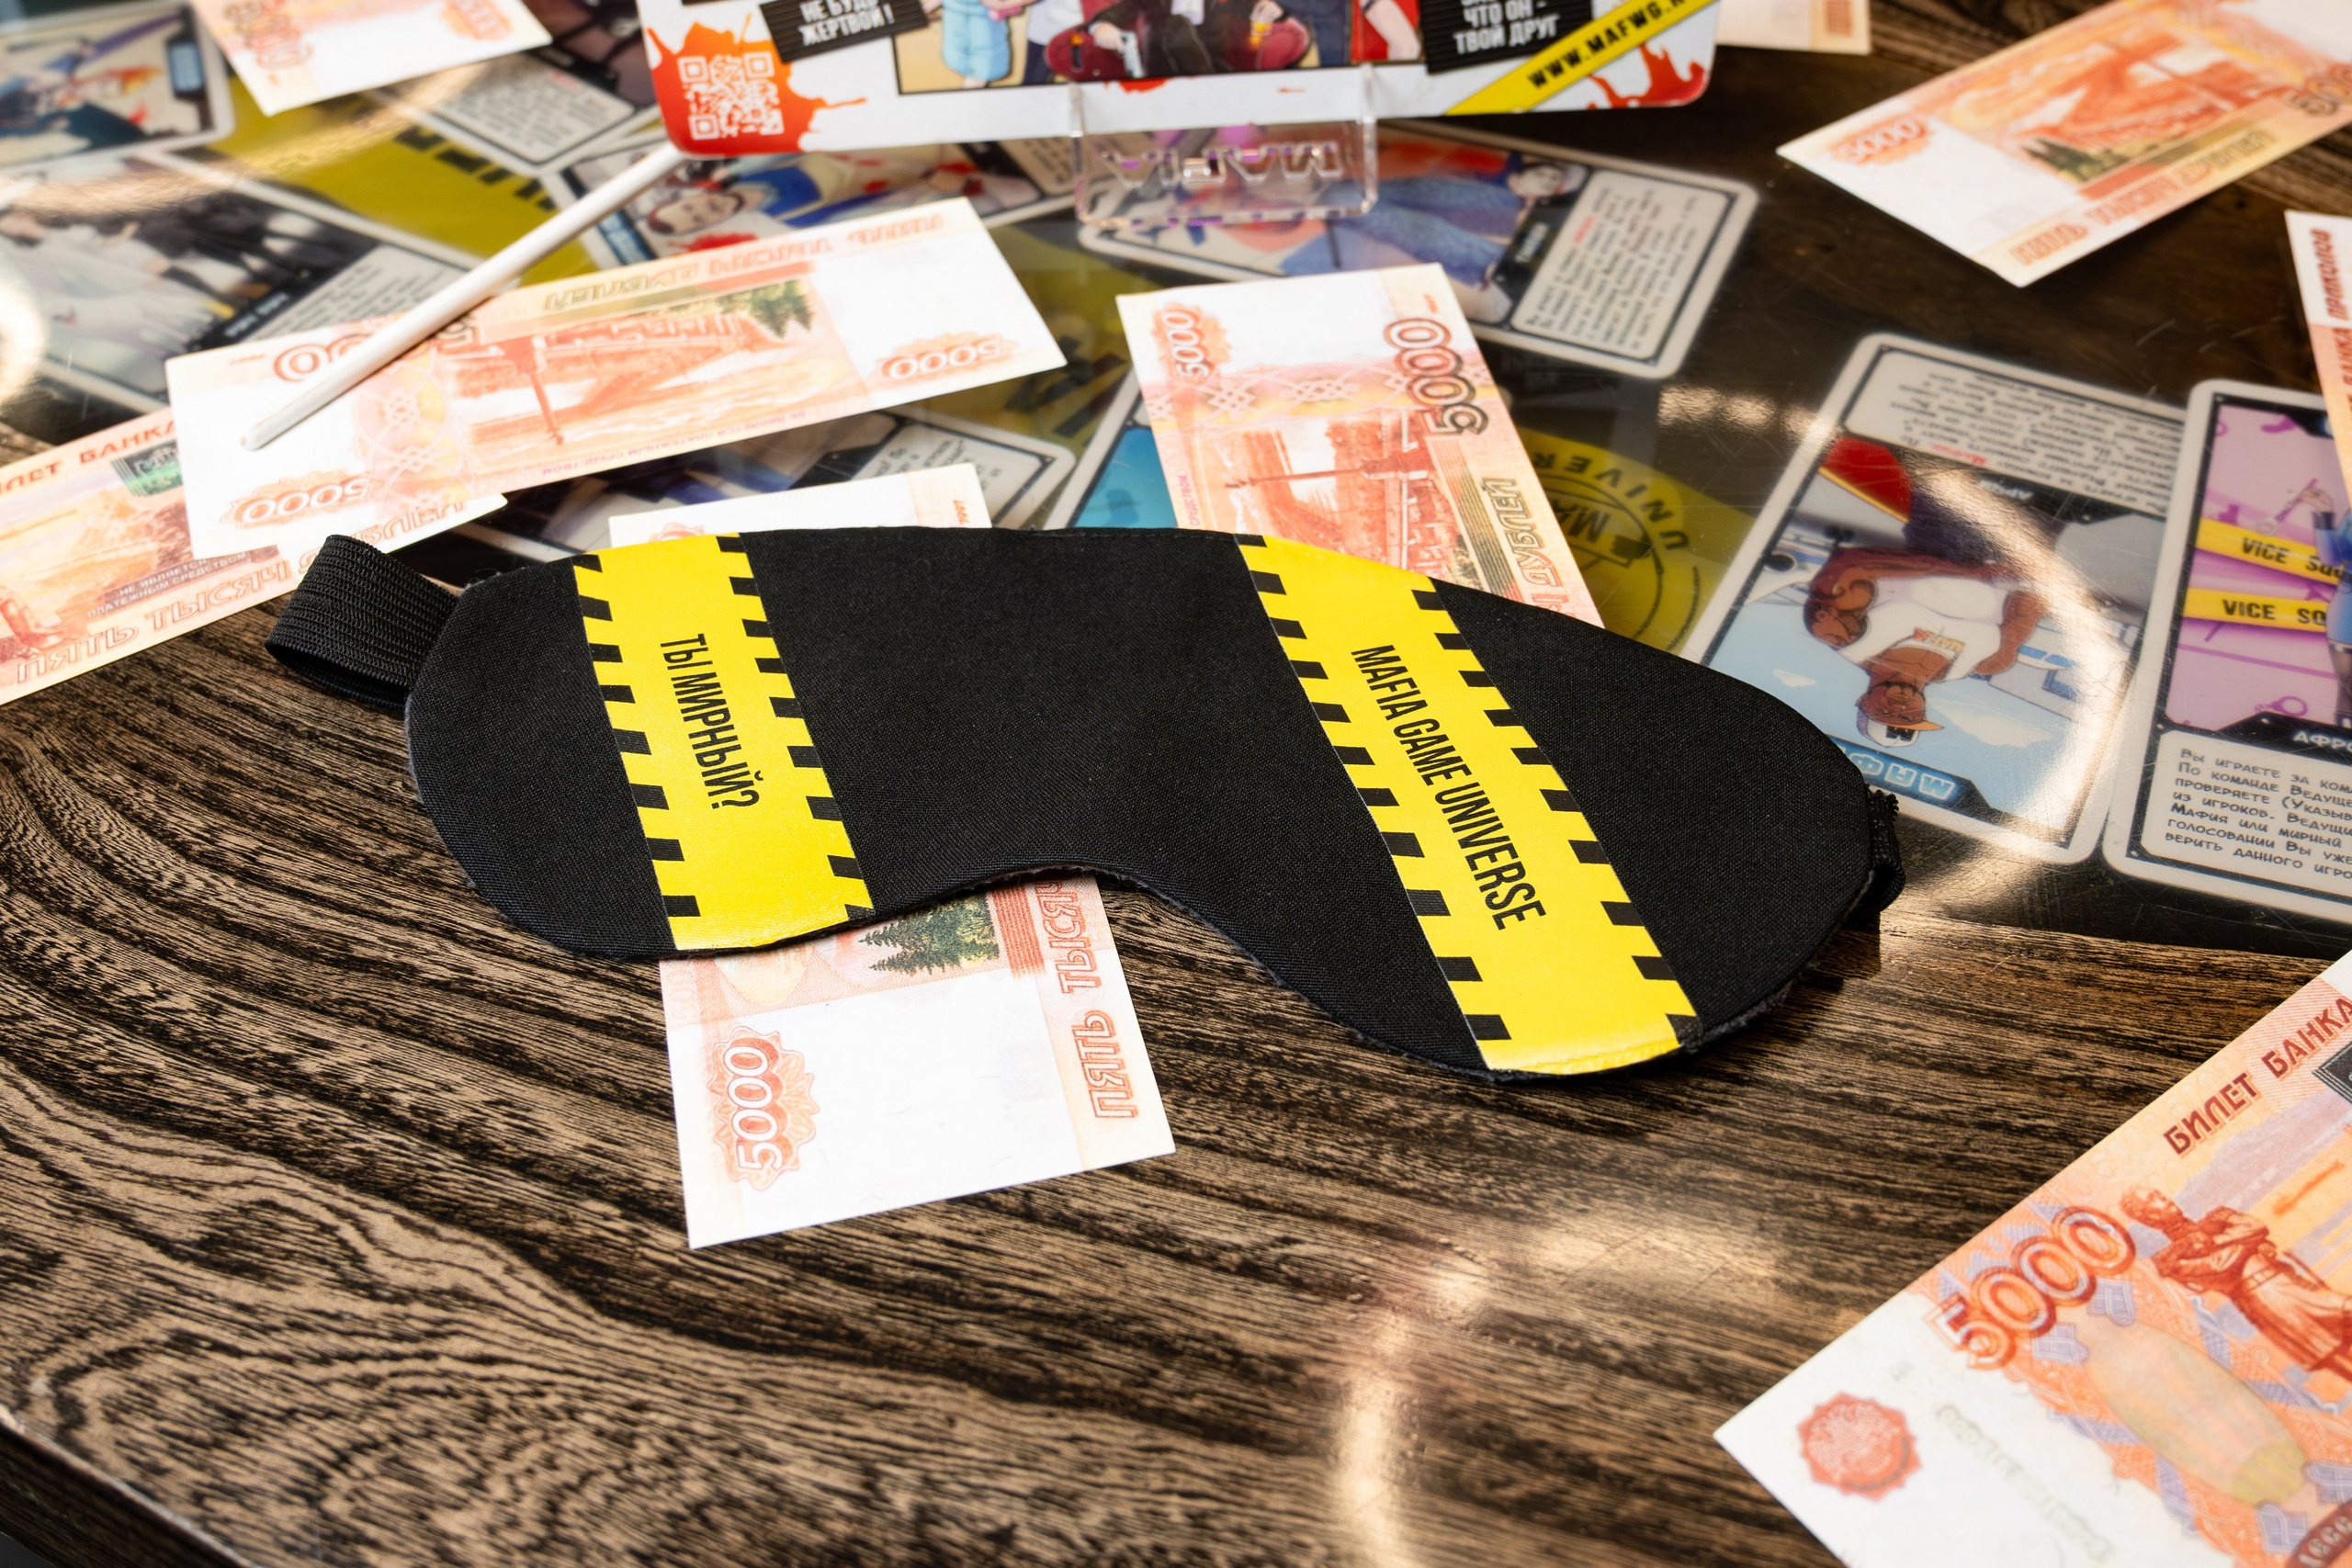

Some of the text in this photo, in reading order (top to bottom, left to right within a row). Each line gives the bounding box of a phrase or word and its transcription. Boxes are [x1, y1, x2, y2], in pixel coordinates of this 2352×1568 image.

[1453, 13, 1560, 54] ТВОЙ ДРУГ
[1464, 2, 1503, 28] ЧТО
[1505, 0, 1533, 20] ОН
[888, 340, 1004, 379] 5000
[1162, 310, 1210, 378] 5000
[1383, 318, 1488, 436] 5000
[0, 461, 62, 494] ЛЕТ
[243, 477, 371, 525] 5000
[1532, 452, 1689, 551] UNIVER
[173, 551, 248, 584] СРЕДСТВОМ
[2242, 536, 2290, 564] VICE
[119, 584, 137, 596] НЕ
[2222, 599, 2326, 626] VICE SQ
[17, 624, 138, 684] ПЯТЬ
[145, 560, 292, 629] ТЫСЯЧ
[661, 633, 763, 809] ТЫ МИРНЫЙ?
[2293, 730, 2352, 753] АФРО
[1351, 645, 1546, 931] MAFIA GAME UNIVERSE
[1838, 745, 1956, 800] МАФ
[2290, 785, 2352, 808] Ведуще
[2314, 863, 2352, 879] игро
[1071, 1010, 1138, 1118] ПЯТЬ
[2163, 998, 2352, 1158] БИЛЕТ БАНКА
[723, 1045, 783, 1171] 5000
[1922, 1205, 2135, 1370] 5000
